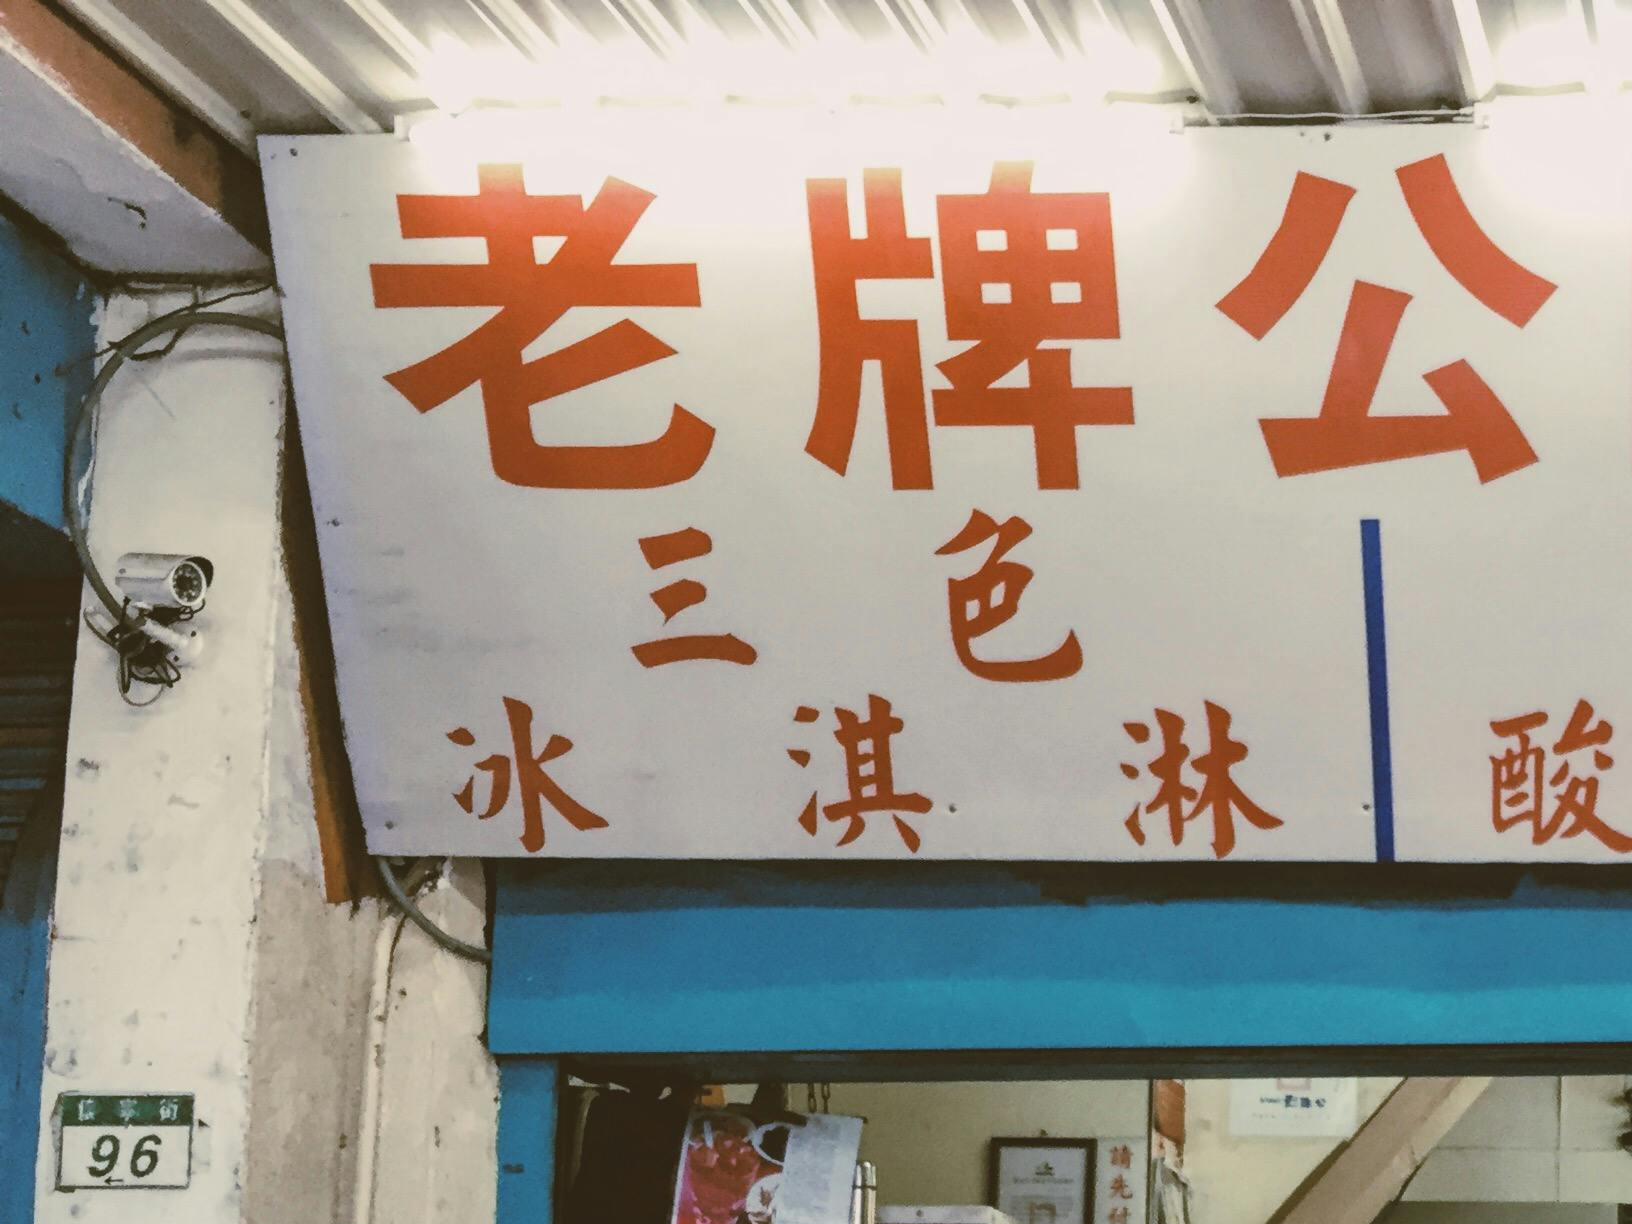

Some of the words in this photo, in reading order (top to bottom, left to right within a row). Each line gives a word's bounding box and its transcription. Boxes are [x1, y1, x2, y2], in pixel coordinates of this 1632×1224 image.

[630, 508, 1083, 683] 三色
[445, 693, 1285, 860] 冰淇淋
[87, 1134, 162, 1178] 96
